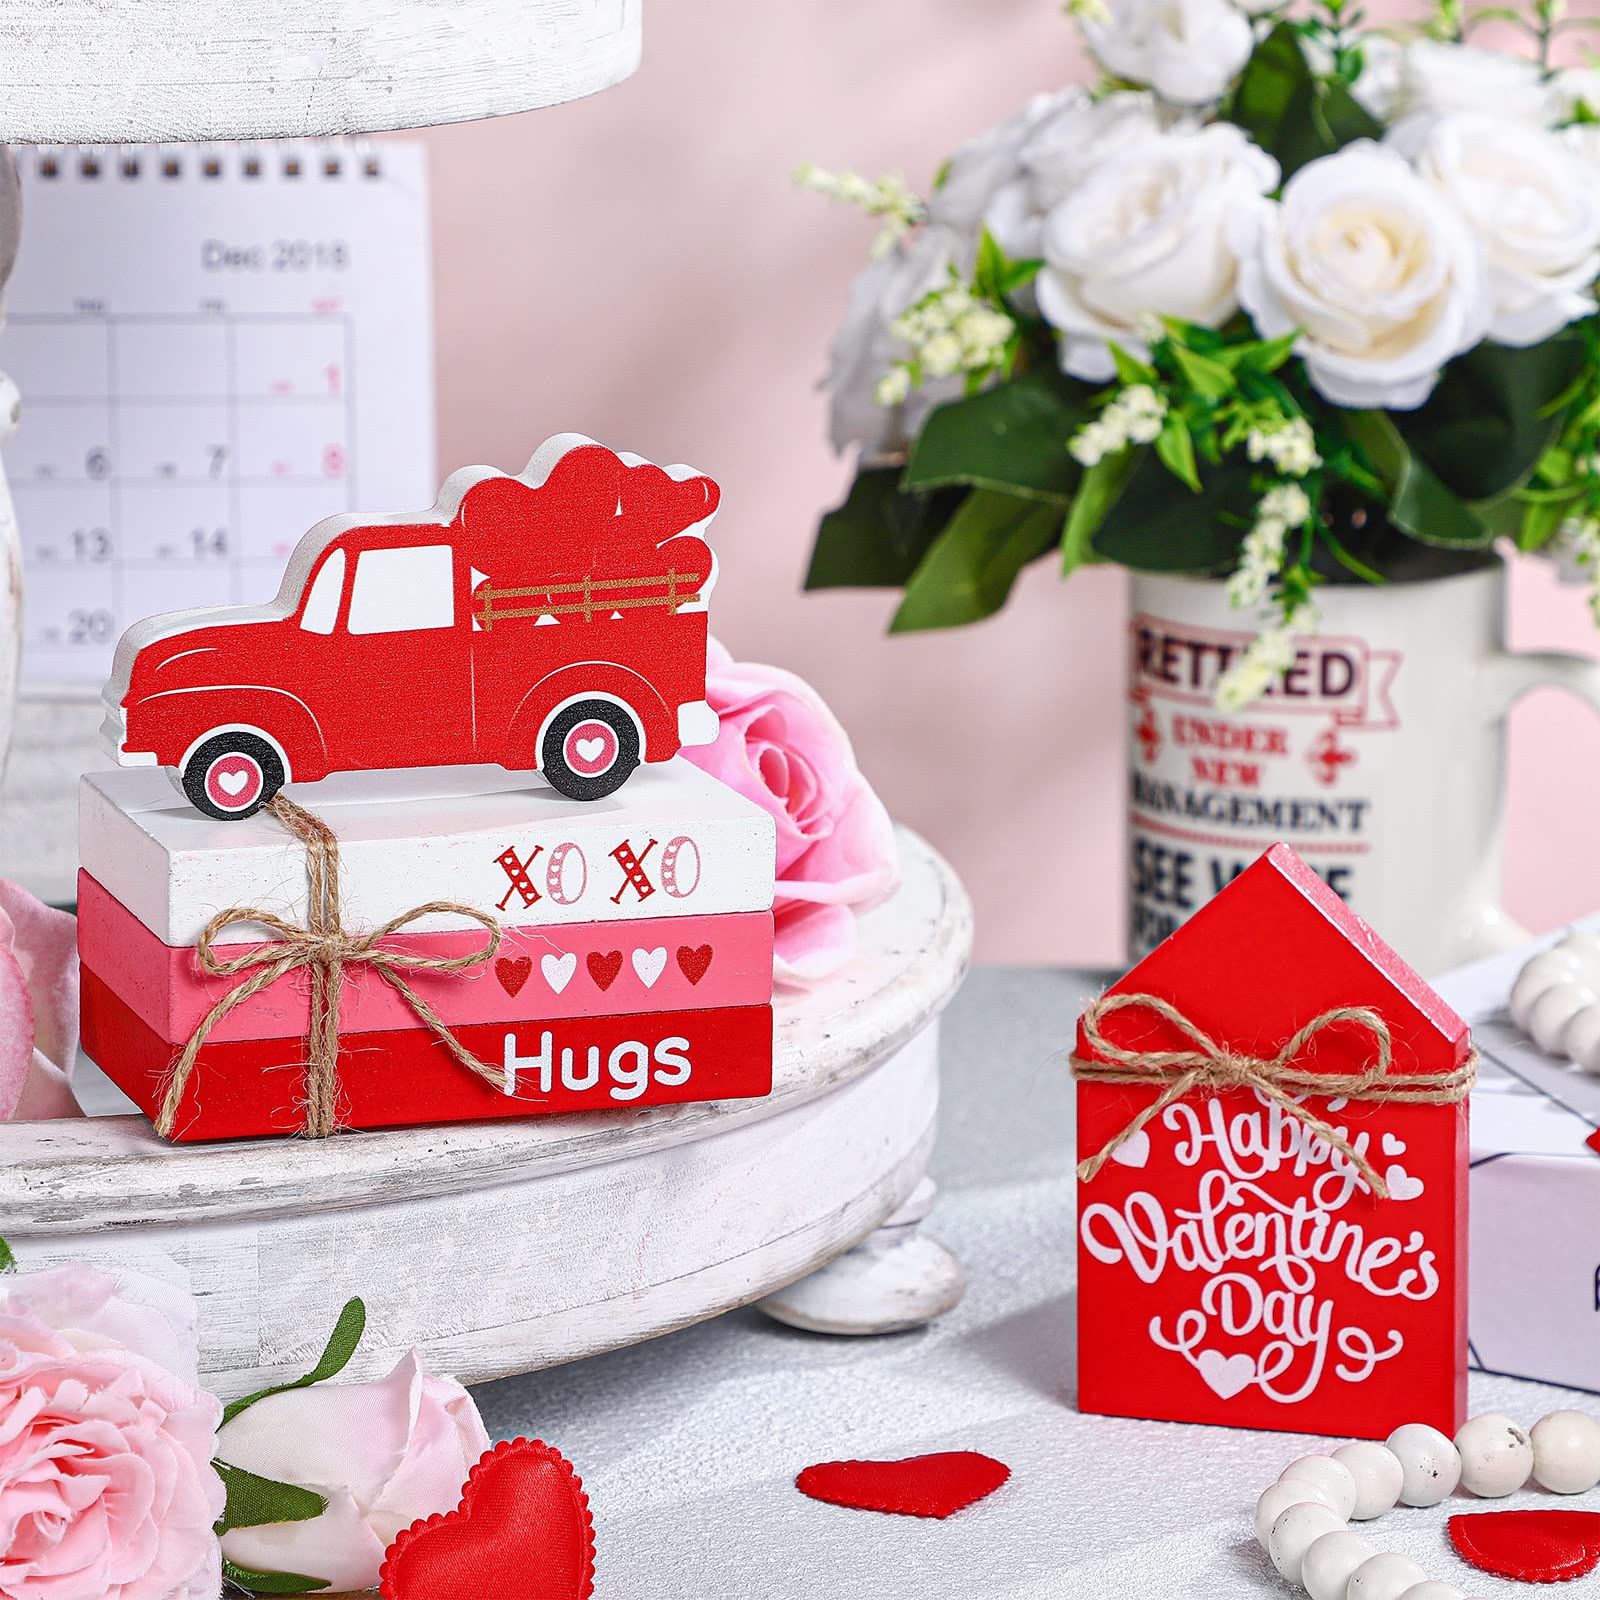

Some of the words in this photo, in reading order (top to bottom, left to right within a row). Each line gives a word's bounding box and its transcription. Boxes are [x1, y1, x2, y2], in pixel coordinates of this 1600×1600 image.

[201, 238, 264, 273] Dec
[207, 444, 229, 480] 7
[191, 529, 228, 560] 14
[68, 609, 114, 644] 20
[1190, 755, 1263, 788] NEW
[503, 1030, 693, 1101] Hugs
[1162, 1085, 1372, 1211] Happy
[1080, 1169, 1440, 1301] Valentine's
[1201, 1271, 1335, 1404] Day
